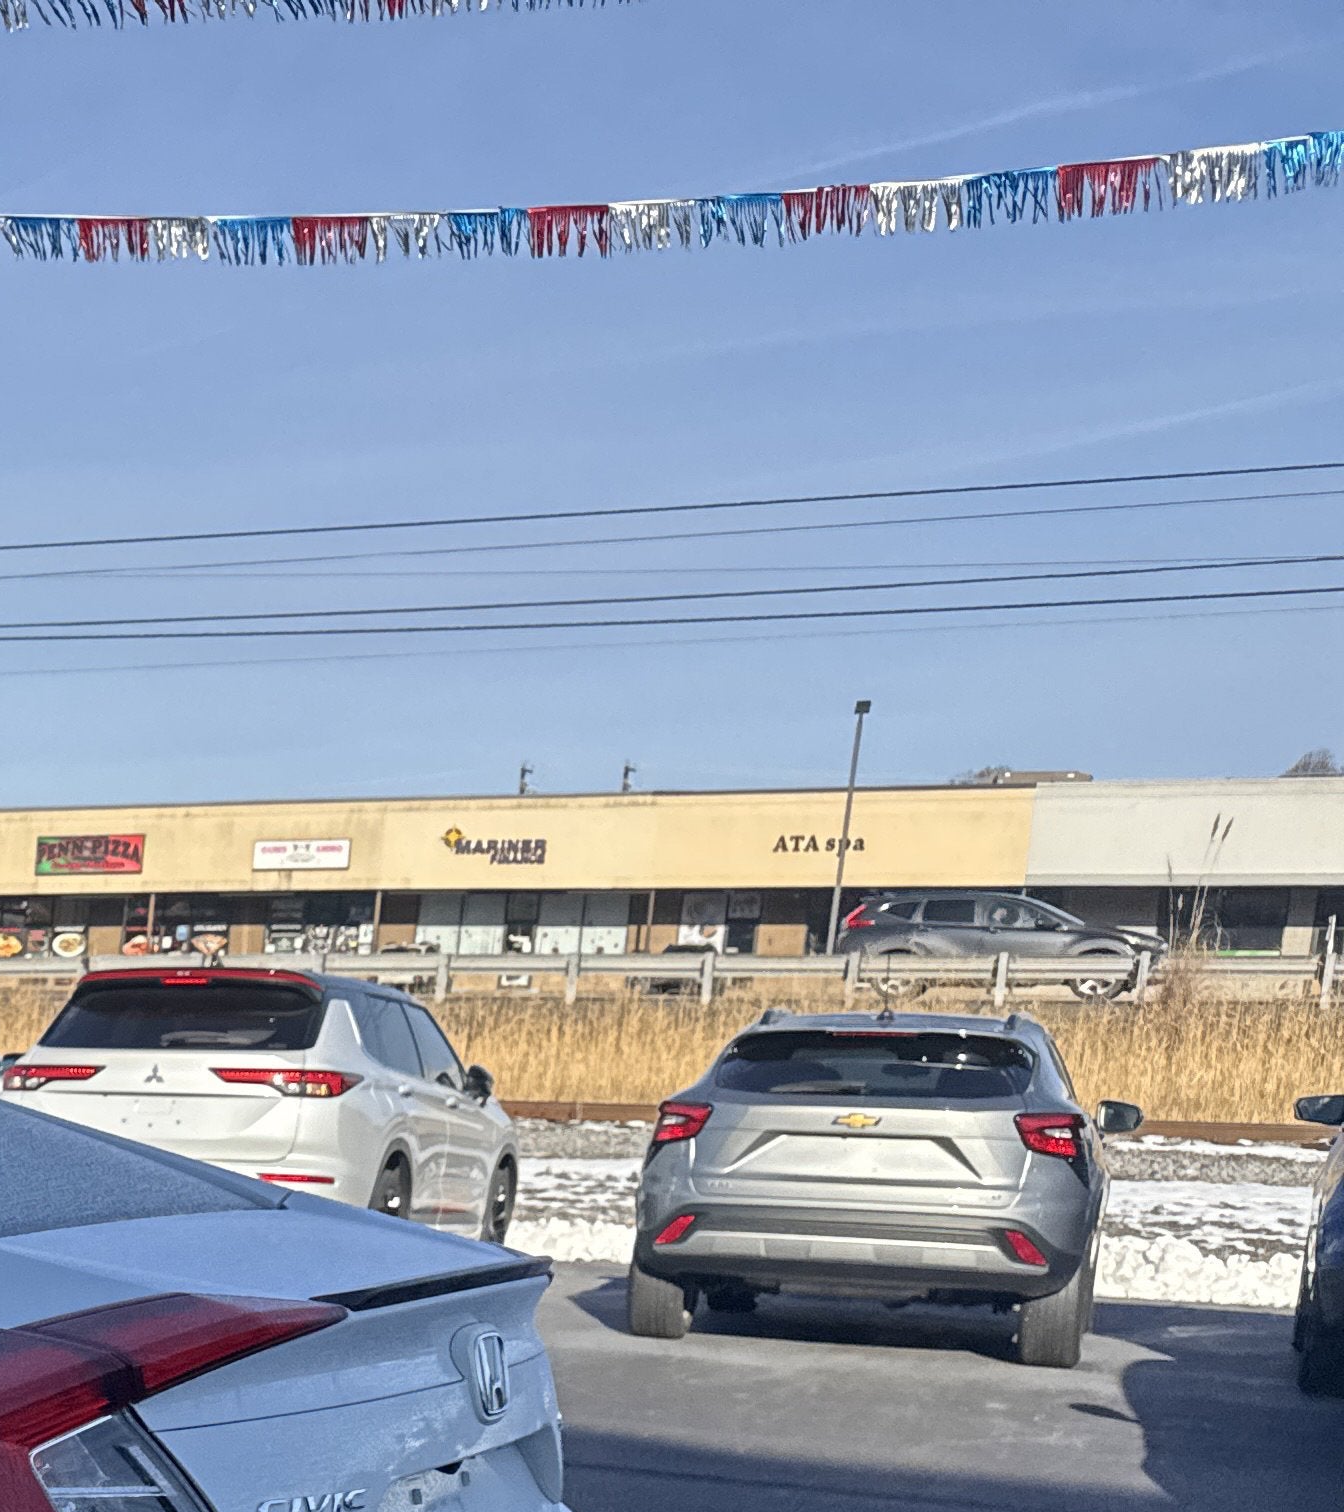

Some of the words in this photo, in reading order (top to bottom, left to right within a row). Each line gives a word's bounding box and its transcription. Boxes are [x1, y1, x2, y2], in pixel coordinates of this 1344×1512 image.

[455, 838, 547, 857] MARINER
[772, 834, 820, 853] ATA
[824, 836, 866, 858] spa
